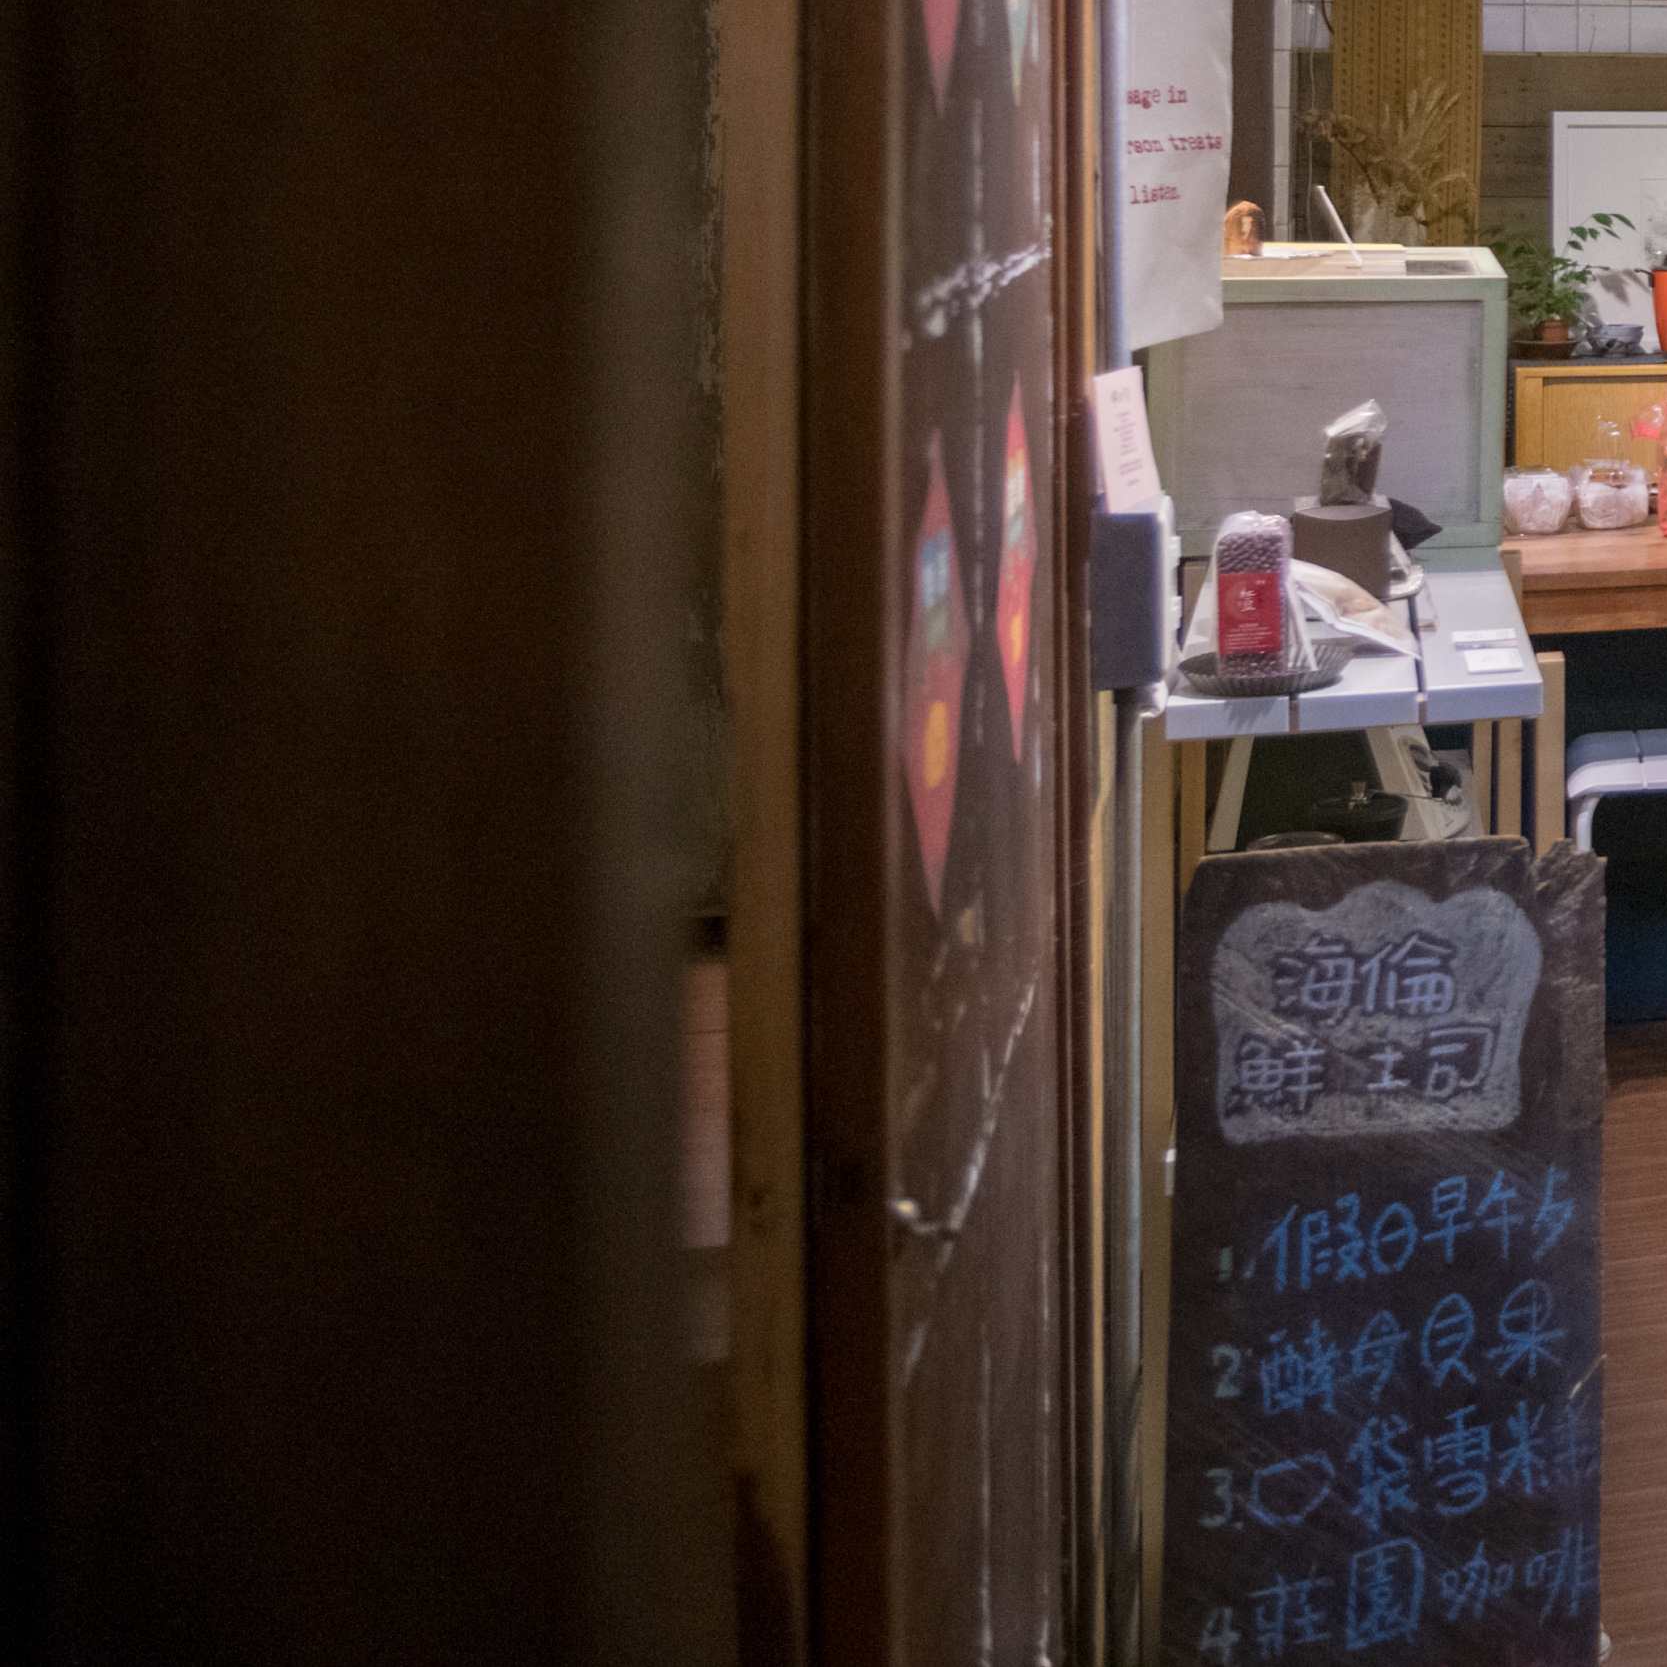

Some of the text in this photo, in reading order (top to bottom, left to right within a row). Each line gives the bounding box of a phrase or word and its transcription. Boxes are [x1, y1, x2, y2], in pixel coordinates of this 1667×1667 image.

[1168, 85, 1187, 104] in
[1168, 133, 1222, 151] treats
[1276, 934, 1456, 1026] 海倫
